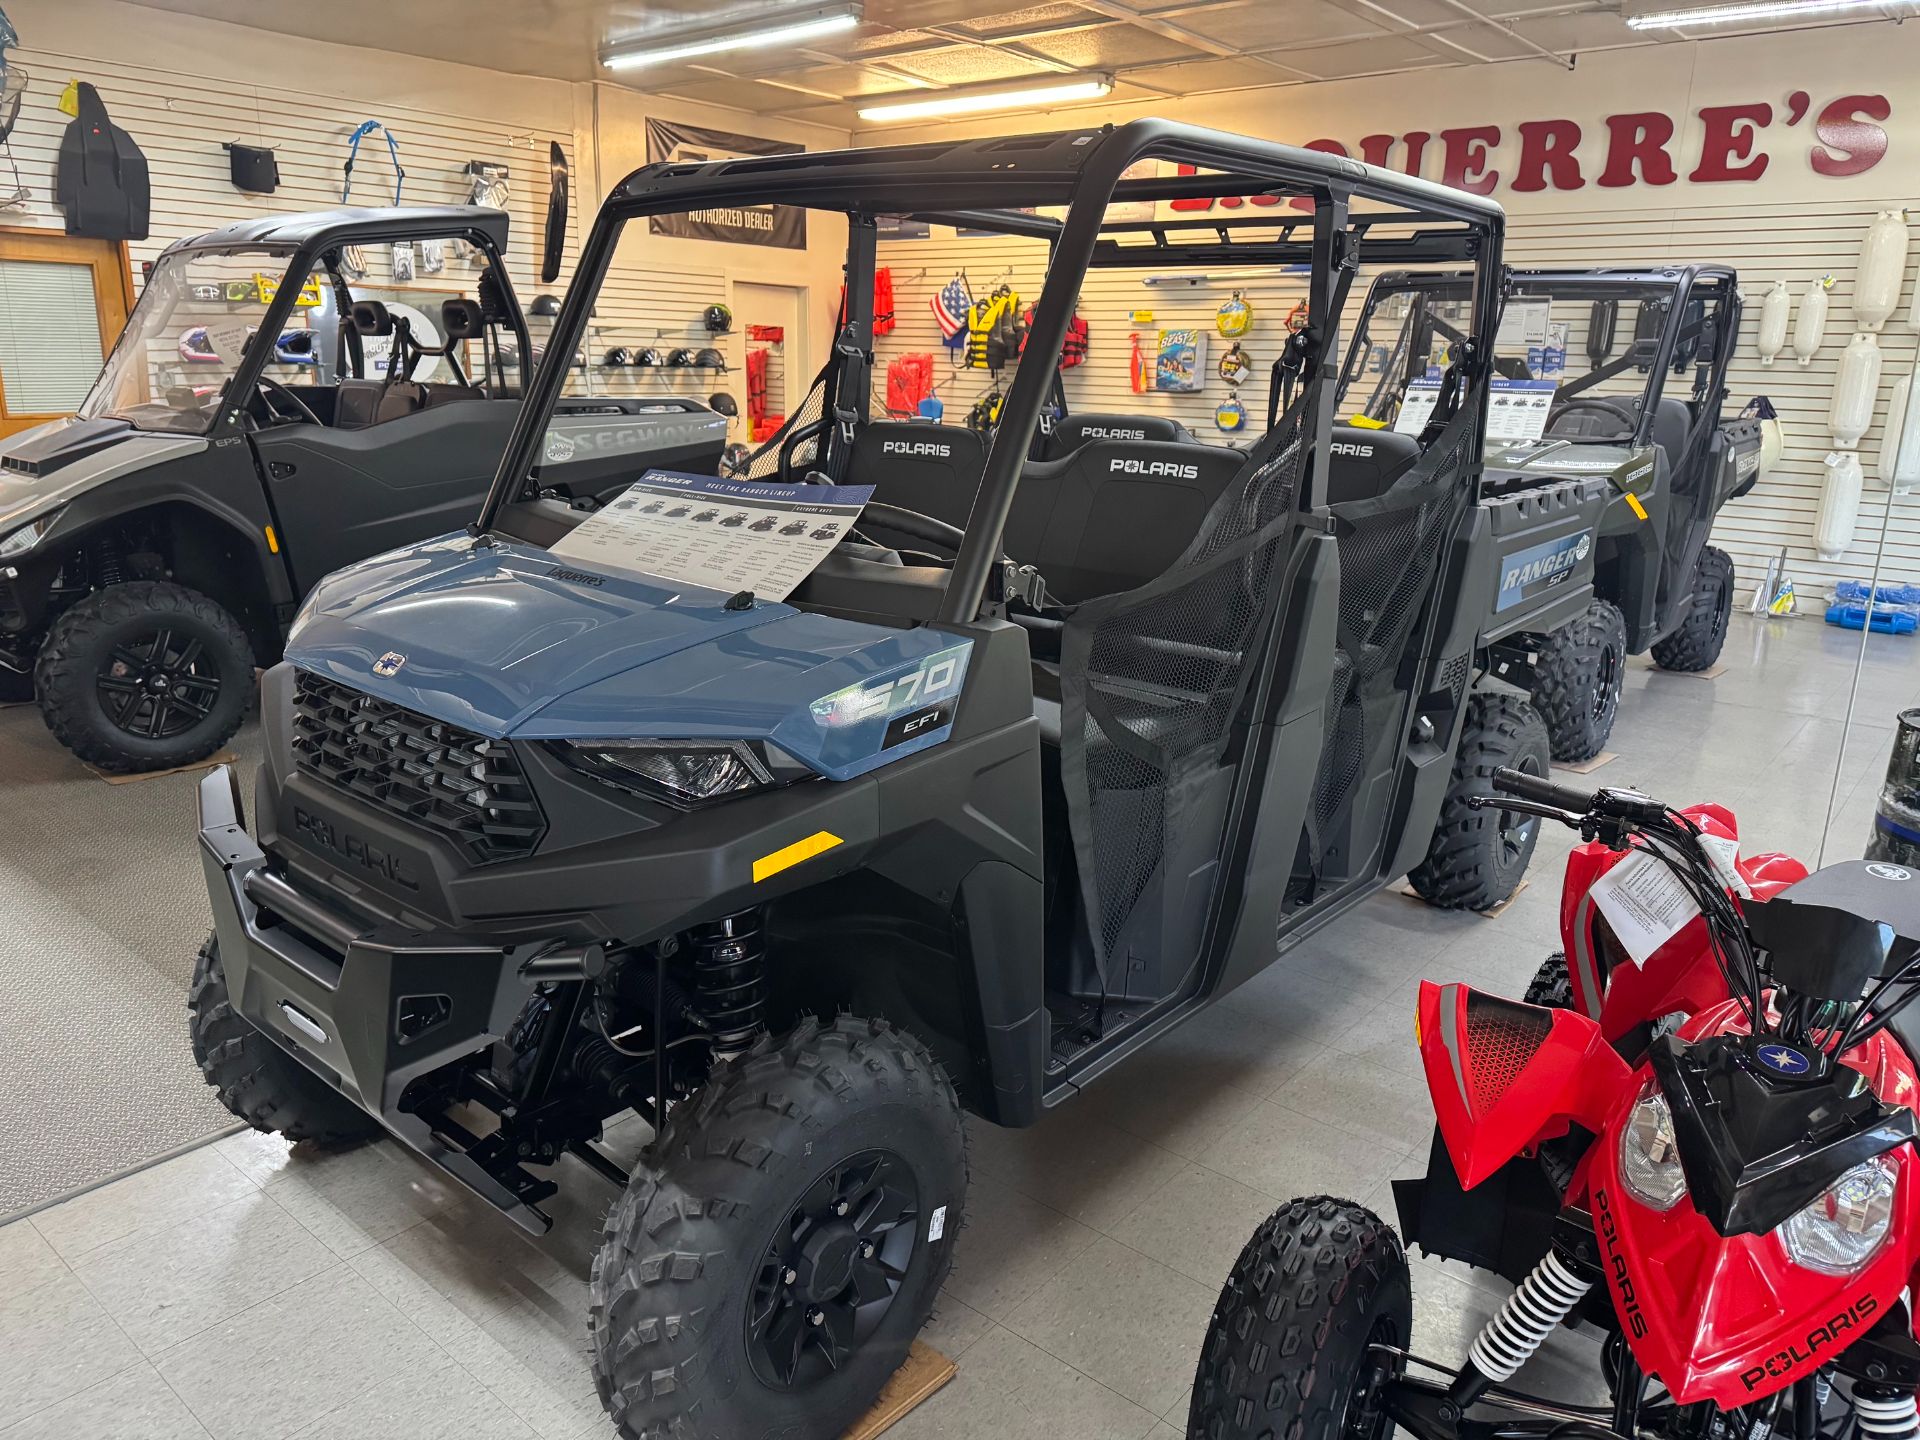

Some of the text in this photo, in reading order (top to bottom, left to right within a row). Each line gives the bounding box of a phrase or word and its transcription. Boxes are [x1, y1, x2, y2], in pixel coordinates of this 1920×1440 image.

[688, 207, 774, 231] AUTHORIZED DEALER
[215, 436, 241, 448] EPS
[1081, 426, 1145, 440] POLARIS
[883, 441, 951, 457] POLARIS
[1330, 442, 1374, 457] ARIS
[1109, 458, 1199, 479] POLARIS
[645, 475, 693, 485] RANGER
[741, 487, 768, 495] RANGER
[769, 489, 797, 497] LINEUP
[1502, 546, 1577, 592] RANGER
[1547, 569, 1569, 588] SP
[903, 711, 939, 734] EFI
[294, 806, 420, 892] POLARIS
[1594, 1188, 1650, 1340] POLARIS
[1739, 1292, 1879, 1393] POLARIS
